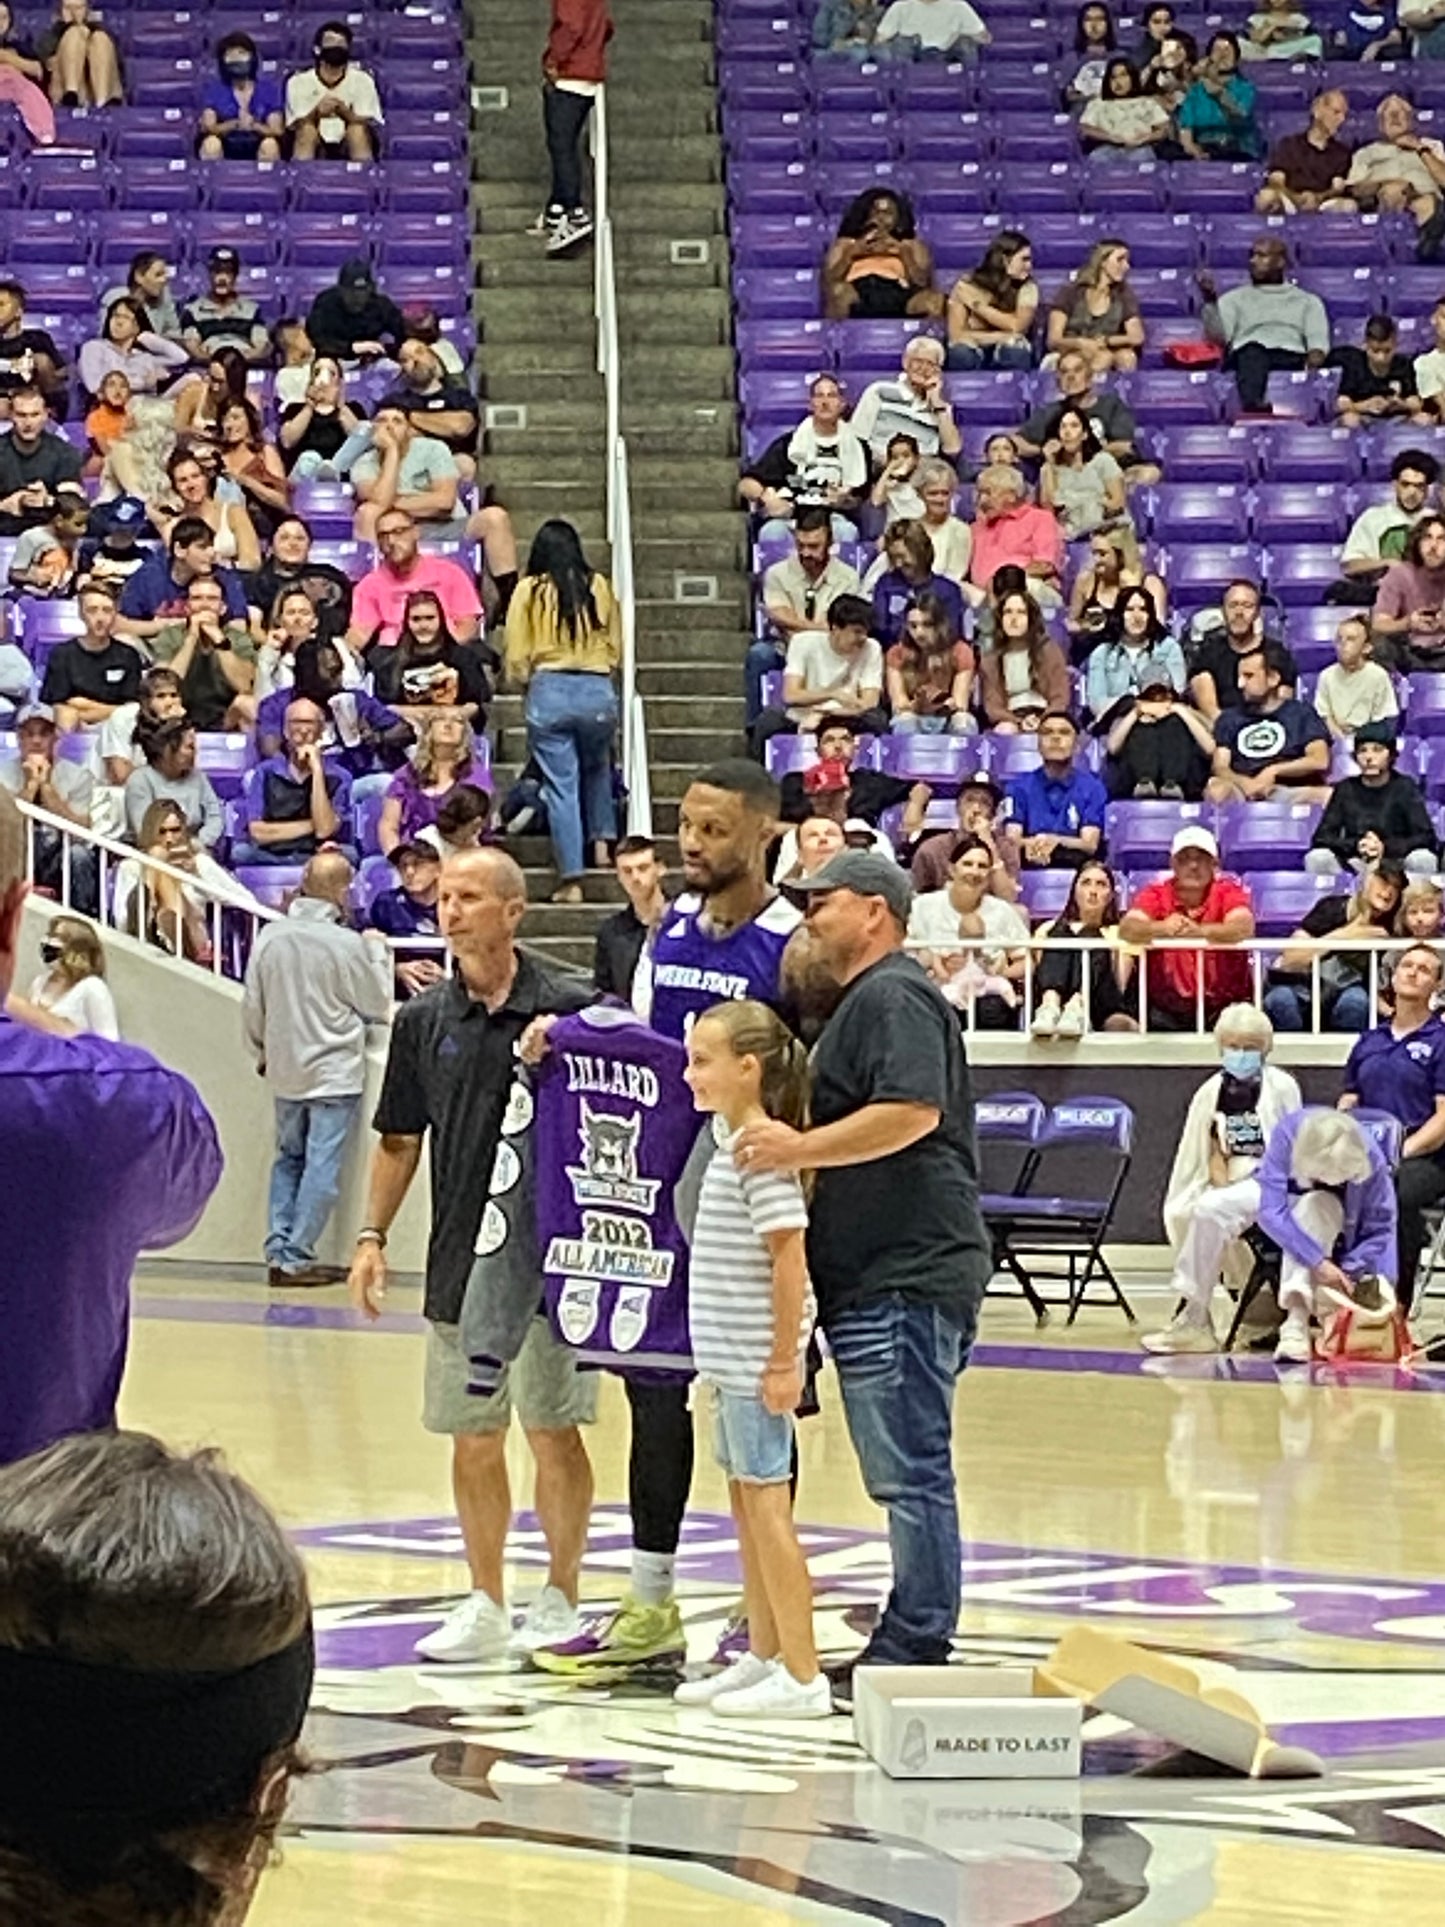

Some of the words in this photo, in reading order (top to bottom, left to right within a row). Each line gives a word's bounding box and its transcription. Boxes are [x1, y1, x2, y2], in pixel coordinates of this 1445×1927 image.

[562, 1052, 660, 1108] LILLARD
[587, 1217, 649, 1250] 2012
[550, 1244, 586, 1271] ALL
[935, 1737, 989, 1752] MADE
[995, 1737, 1021, 1752] TO
[1025, 1737, 1071, 1752] LAST
